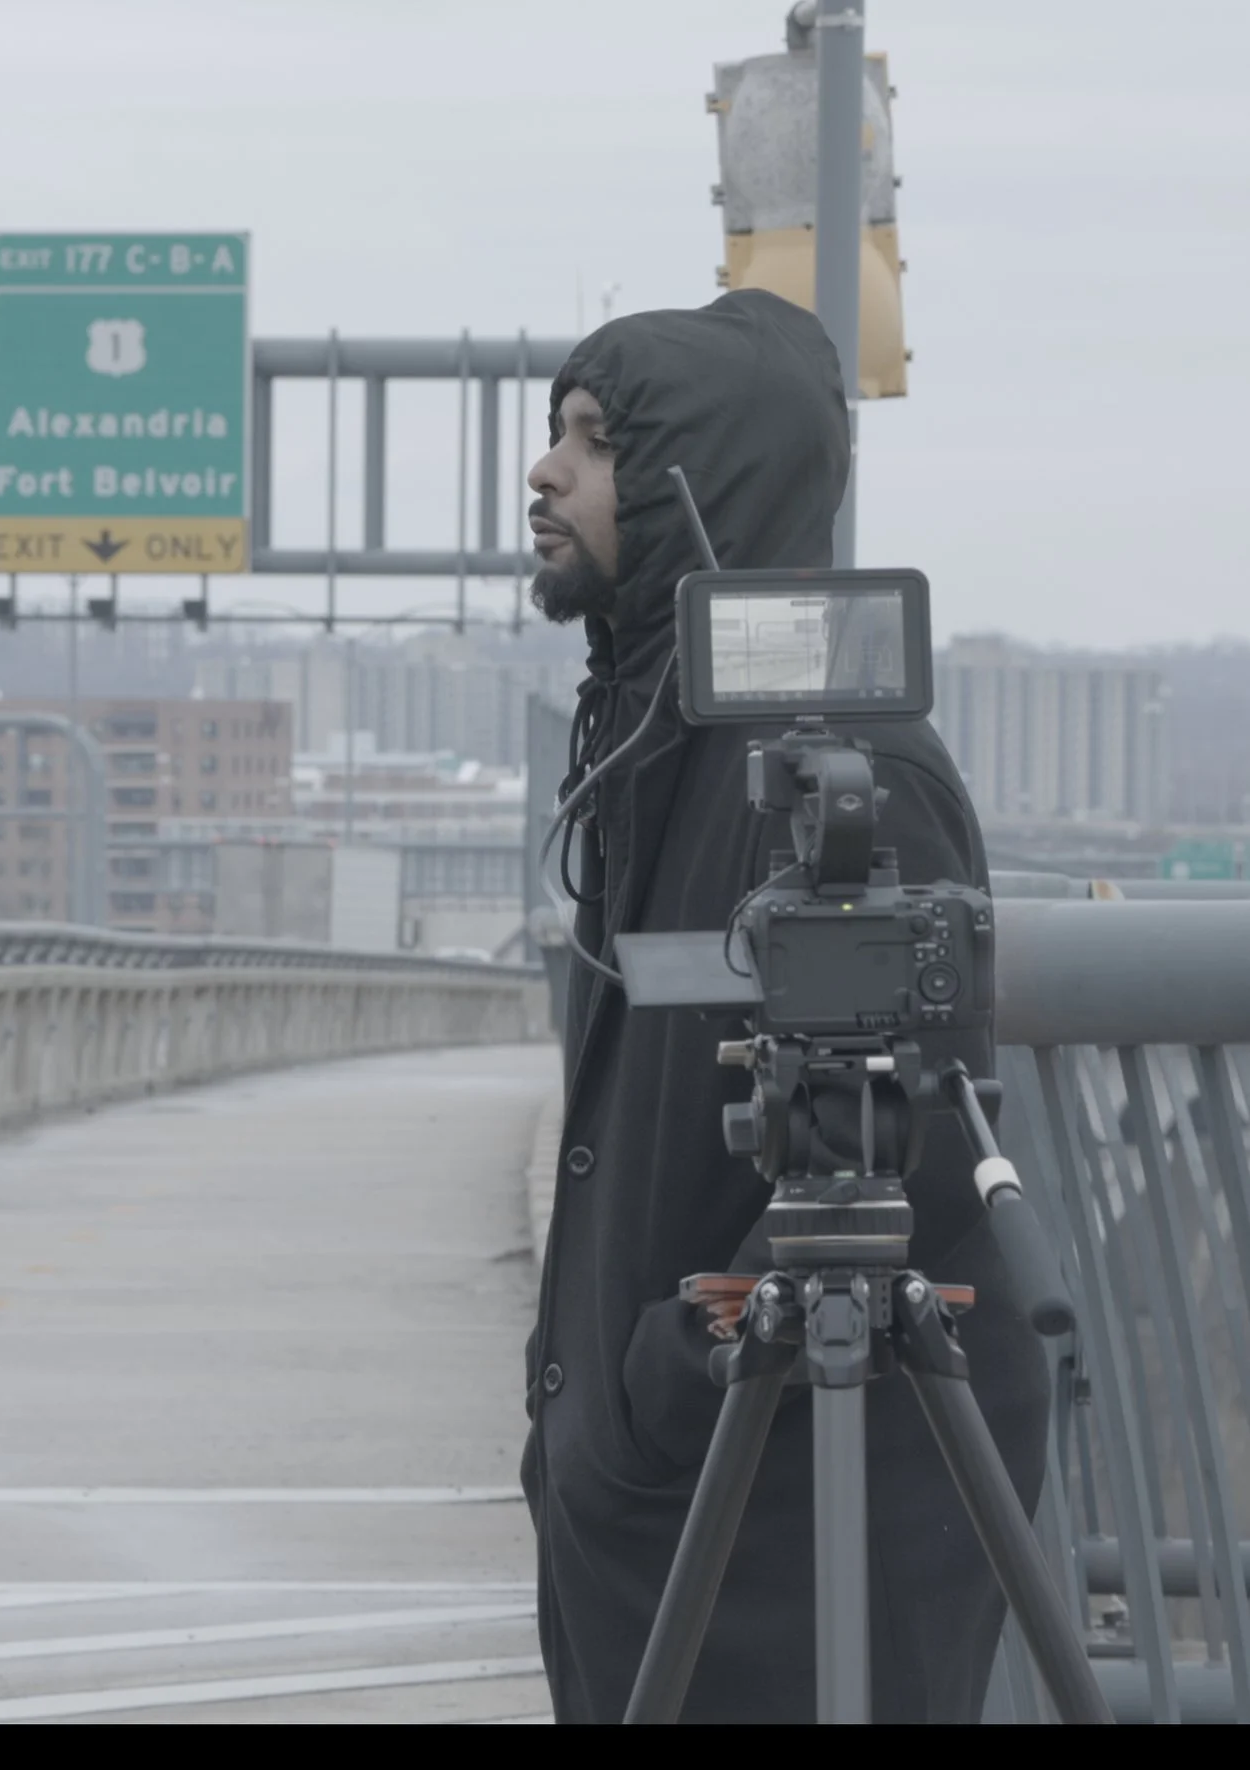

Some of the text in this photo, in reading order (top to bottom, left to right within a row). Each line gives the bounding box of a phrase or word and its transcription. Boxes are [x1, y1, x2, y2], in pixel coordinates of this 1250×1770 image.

[65, 243, 113, 273] 177
[110, 332, 121, 362] 1
[7, 407, 227, 437] Alexandria
[93, 466, 236, 497] Belvoir
[146, 535, 237, 561] ONLY
